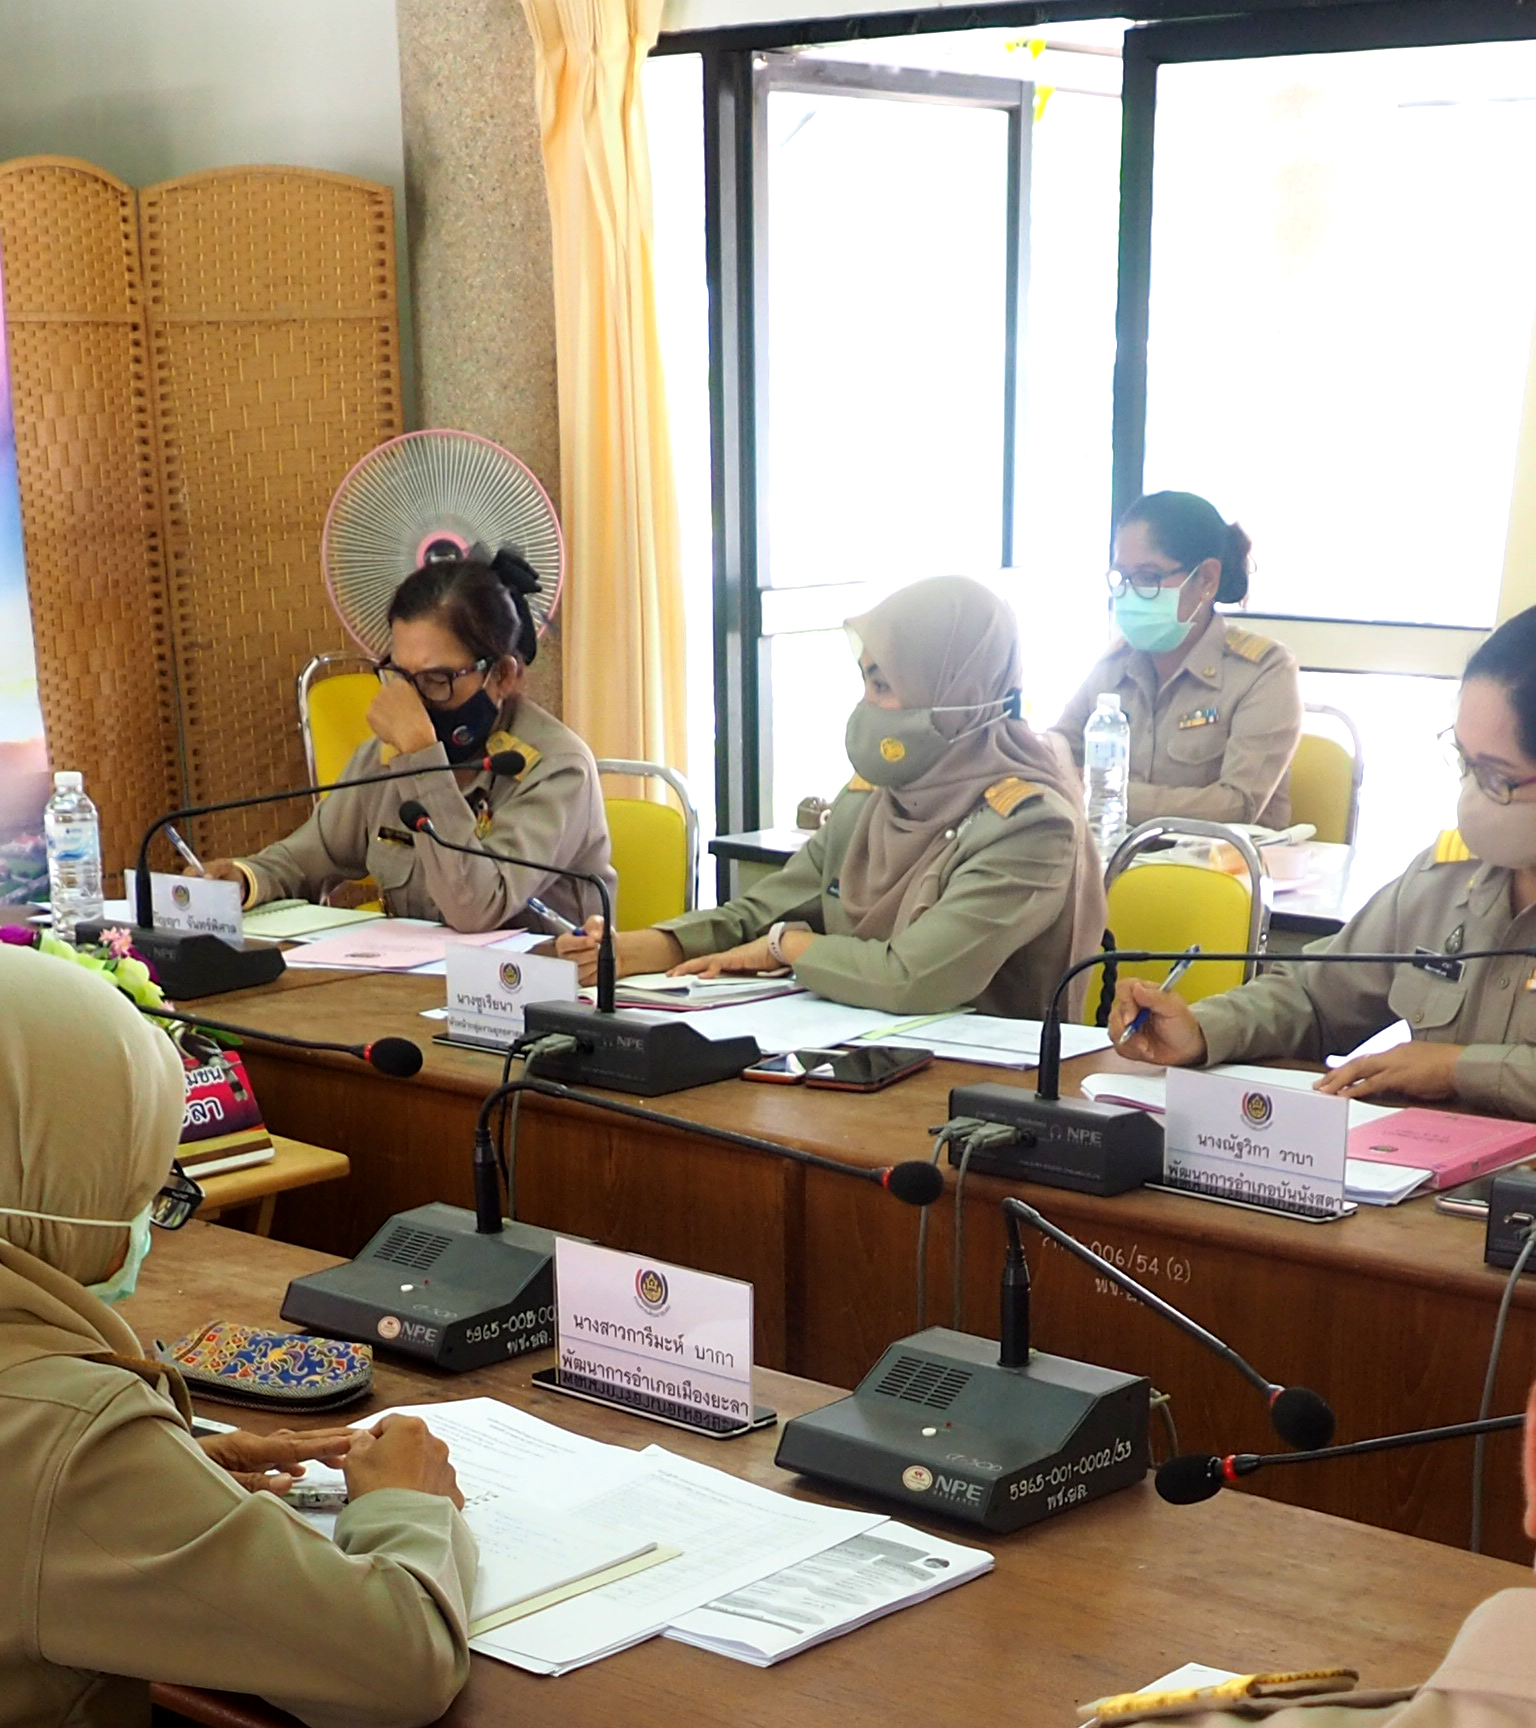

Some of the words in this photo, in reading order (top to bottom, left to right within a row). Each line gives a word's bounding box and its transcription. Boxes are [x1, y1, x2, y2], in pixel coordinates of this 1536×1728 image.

[1067, 1126, 1103, 1141] NPE
[400, 1320, 438, 1343] NPE
[573, 1313, 685, 1356] นางสาวการีมะห์
[695, 1344, 734, 1369] บากา
[561, 1347, 749, 1418] พัฒนาการอำเภอเมืองยะลา
[935, 1475, 984, 1501] NPE
